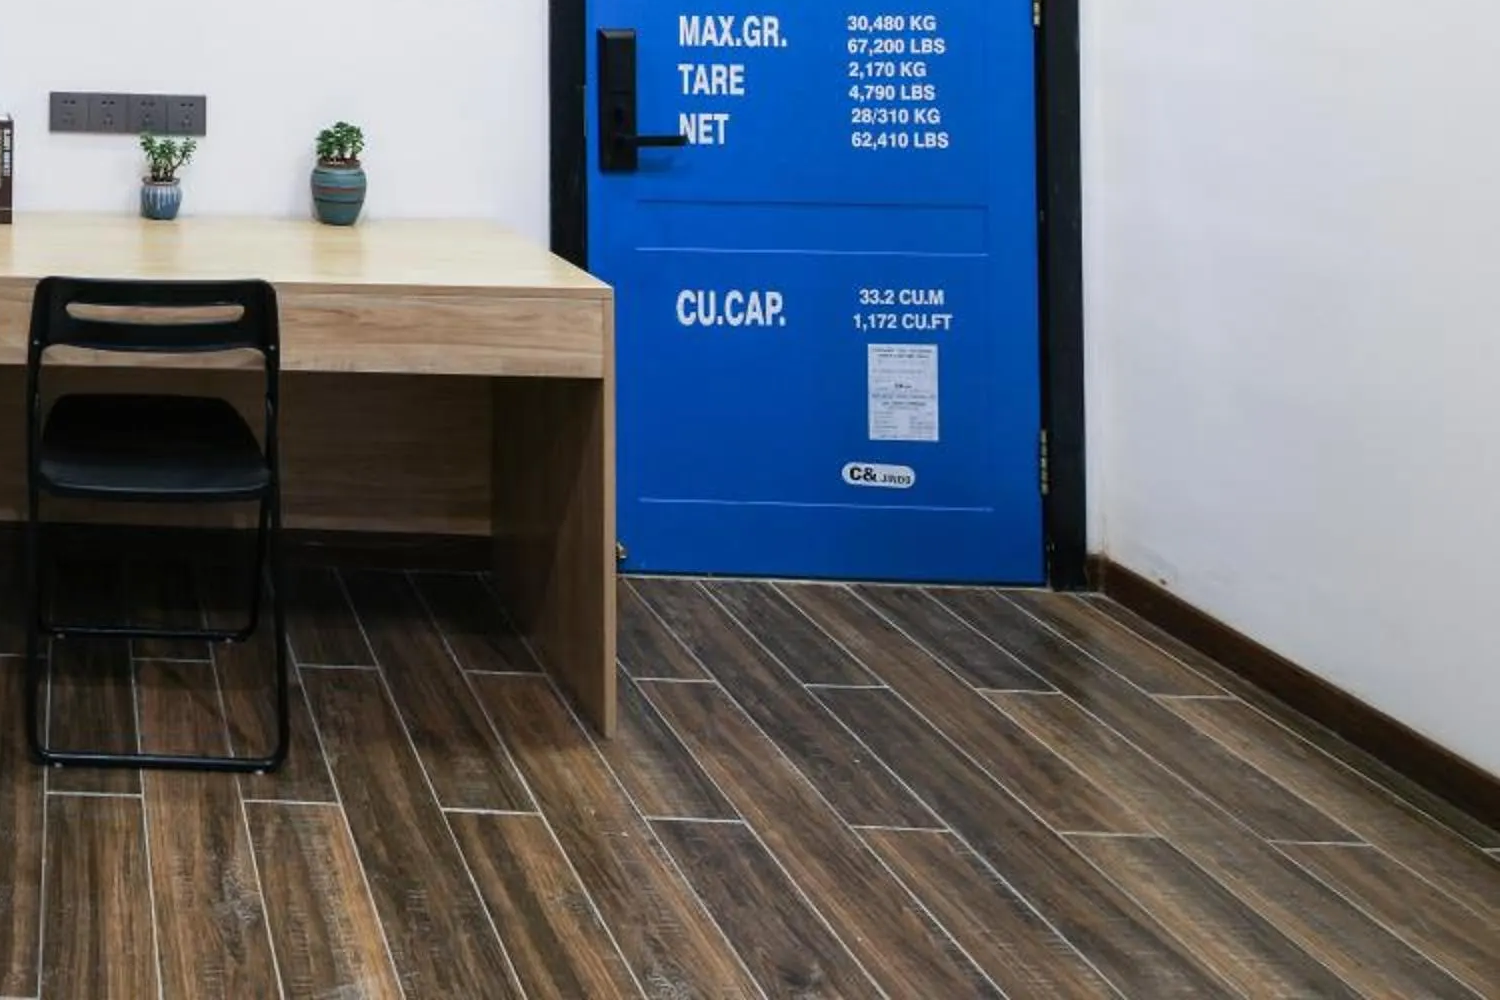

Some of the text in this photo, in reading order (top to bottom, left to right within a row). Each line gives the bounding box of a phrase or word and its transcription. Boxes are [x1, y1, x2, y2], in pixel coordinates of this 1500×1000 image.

[679, 15, 787, 48] MAX.GR.
[847, 15, 937, 33] 30,480 KG
[847, 38, 946, 56] 67,200 LBS
[848, 61, 927, 79] 2,170 KG
[678, 63, 745, 96] TARE
[848, 84, 936, 102] 4,790 LBS
[851, 107, 941, 125] 28,310 KG
[679, 112, 730, 145] NET
[851, 131, 949, 150] 62,410 LBS
[859, 288, 944, 306] 33.2 CU.M
[675, 289, 786, 327] CU.CAP.
[853, 313, 953, 331] 1,172 CU.FT
